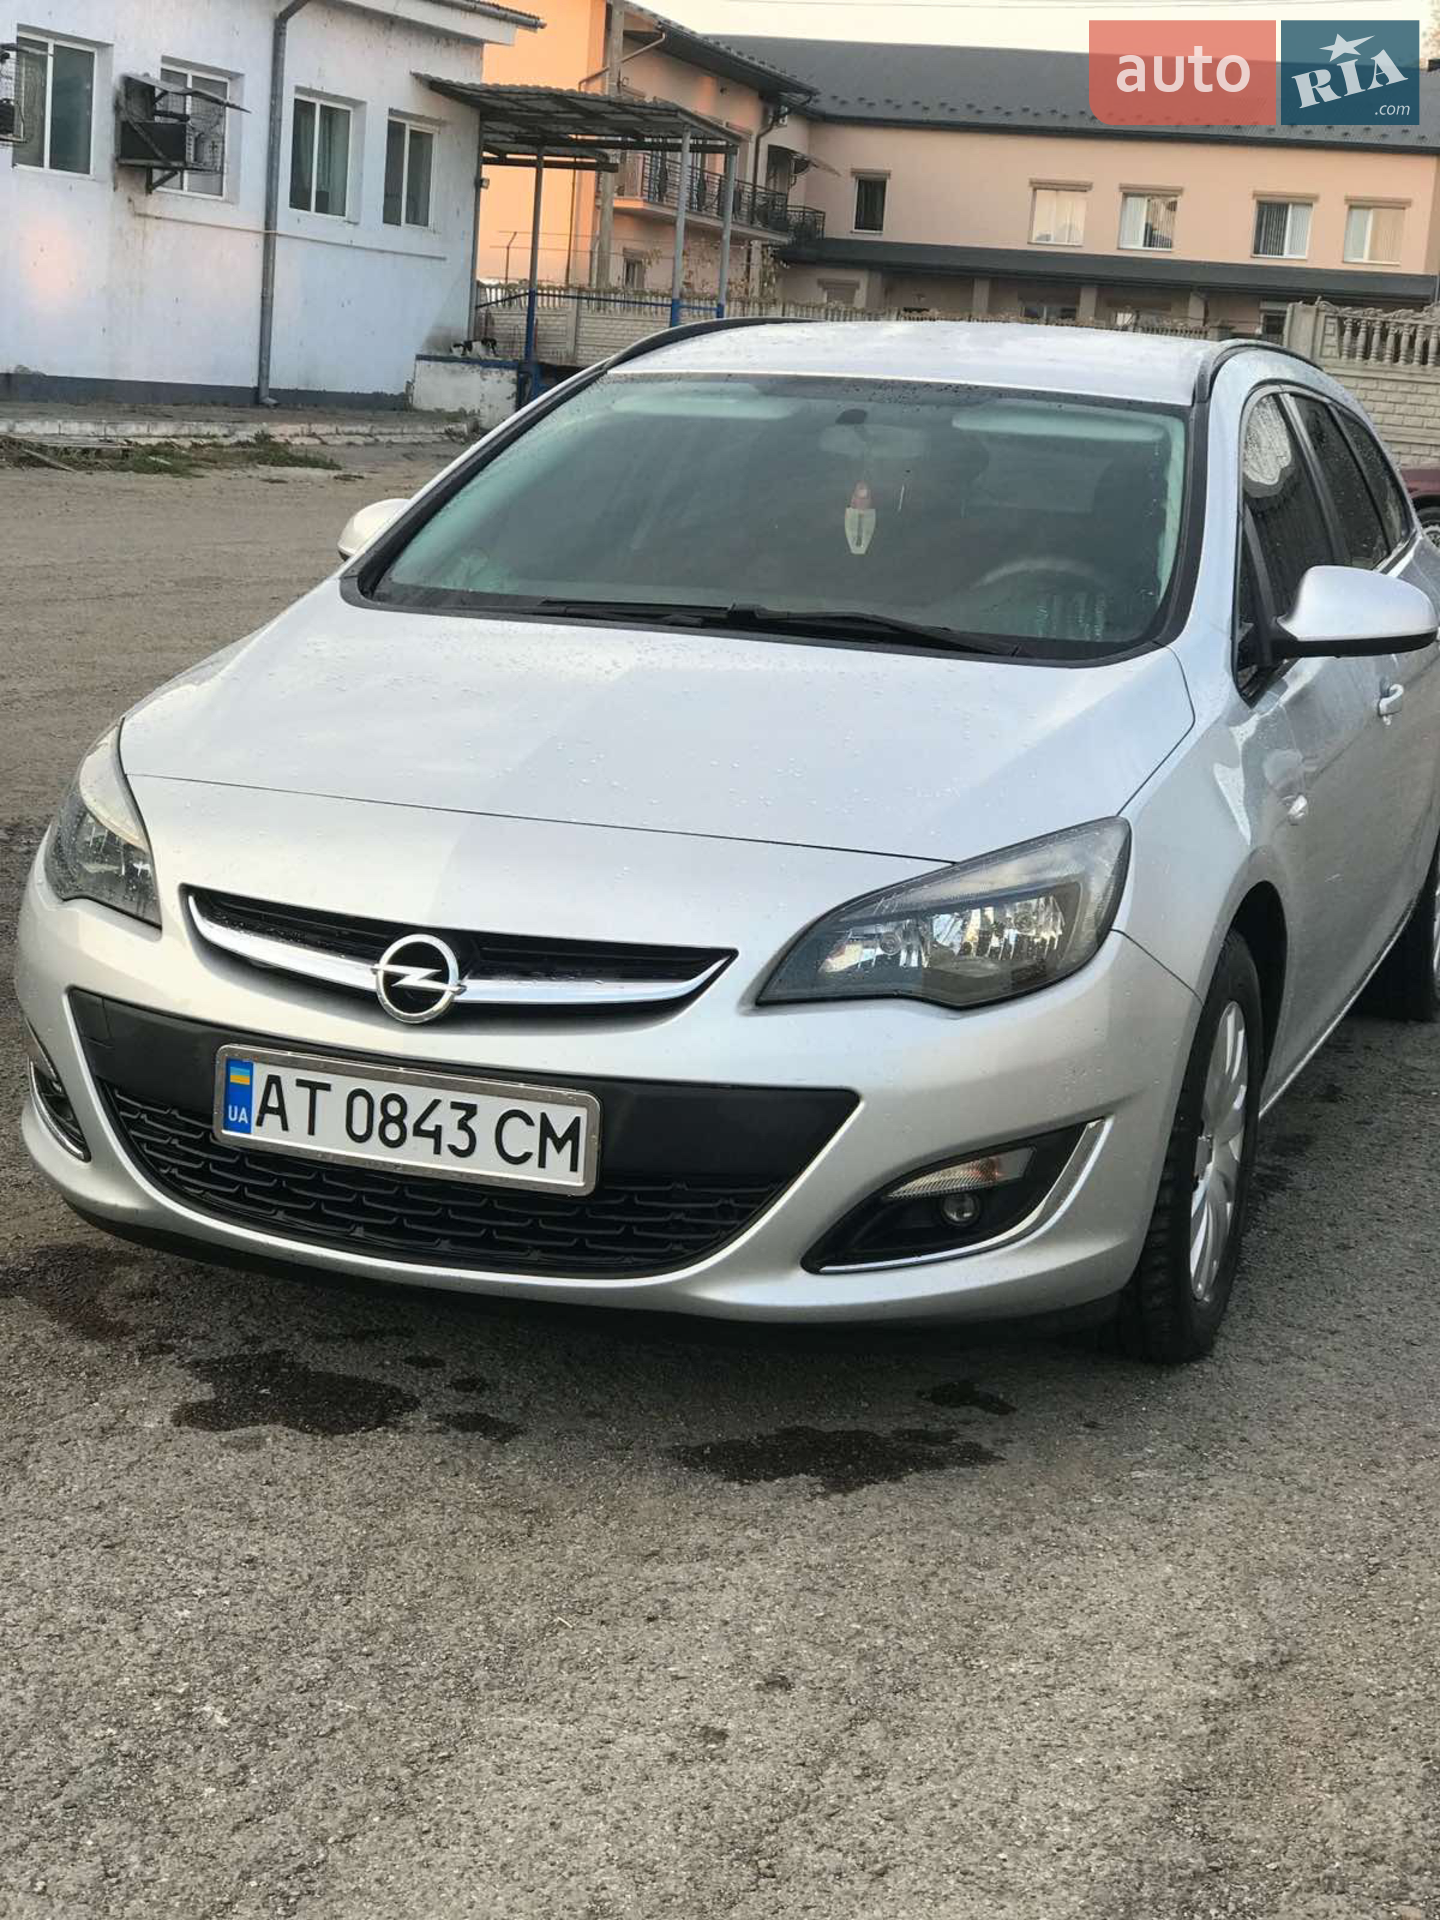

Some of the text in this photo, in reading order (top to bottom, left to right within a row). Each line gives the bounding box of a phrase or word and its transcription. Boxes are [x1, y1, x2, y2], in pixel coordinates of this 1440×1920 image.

[228, 1105, 249, 1124] UA
[256, 1074, 581, 1173] AT 0843 CM
